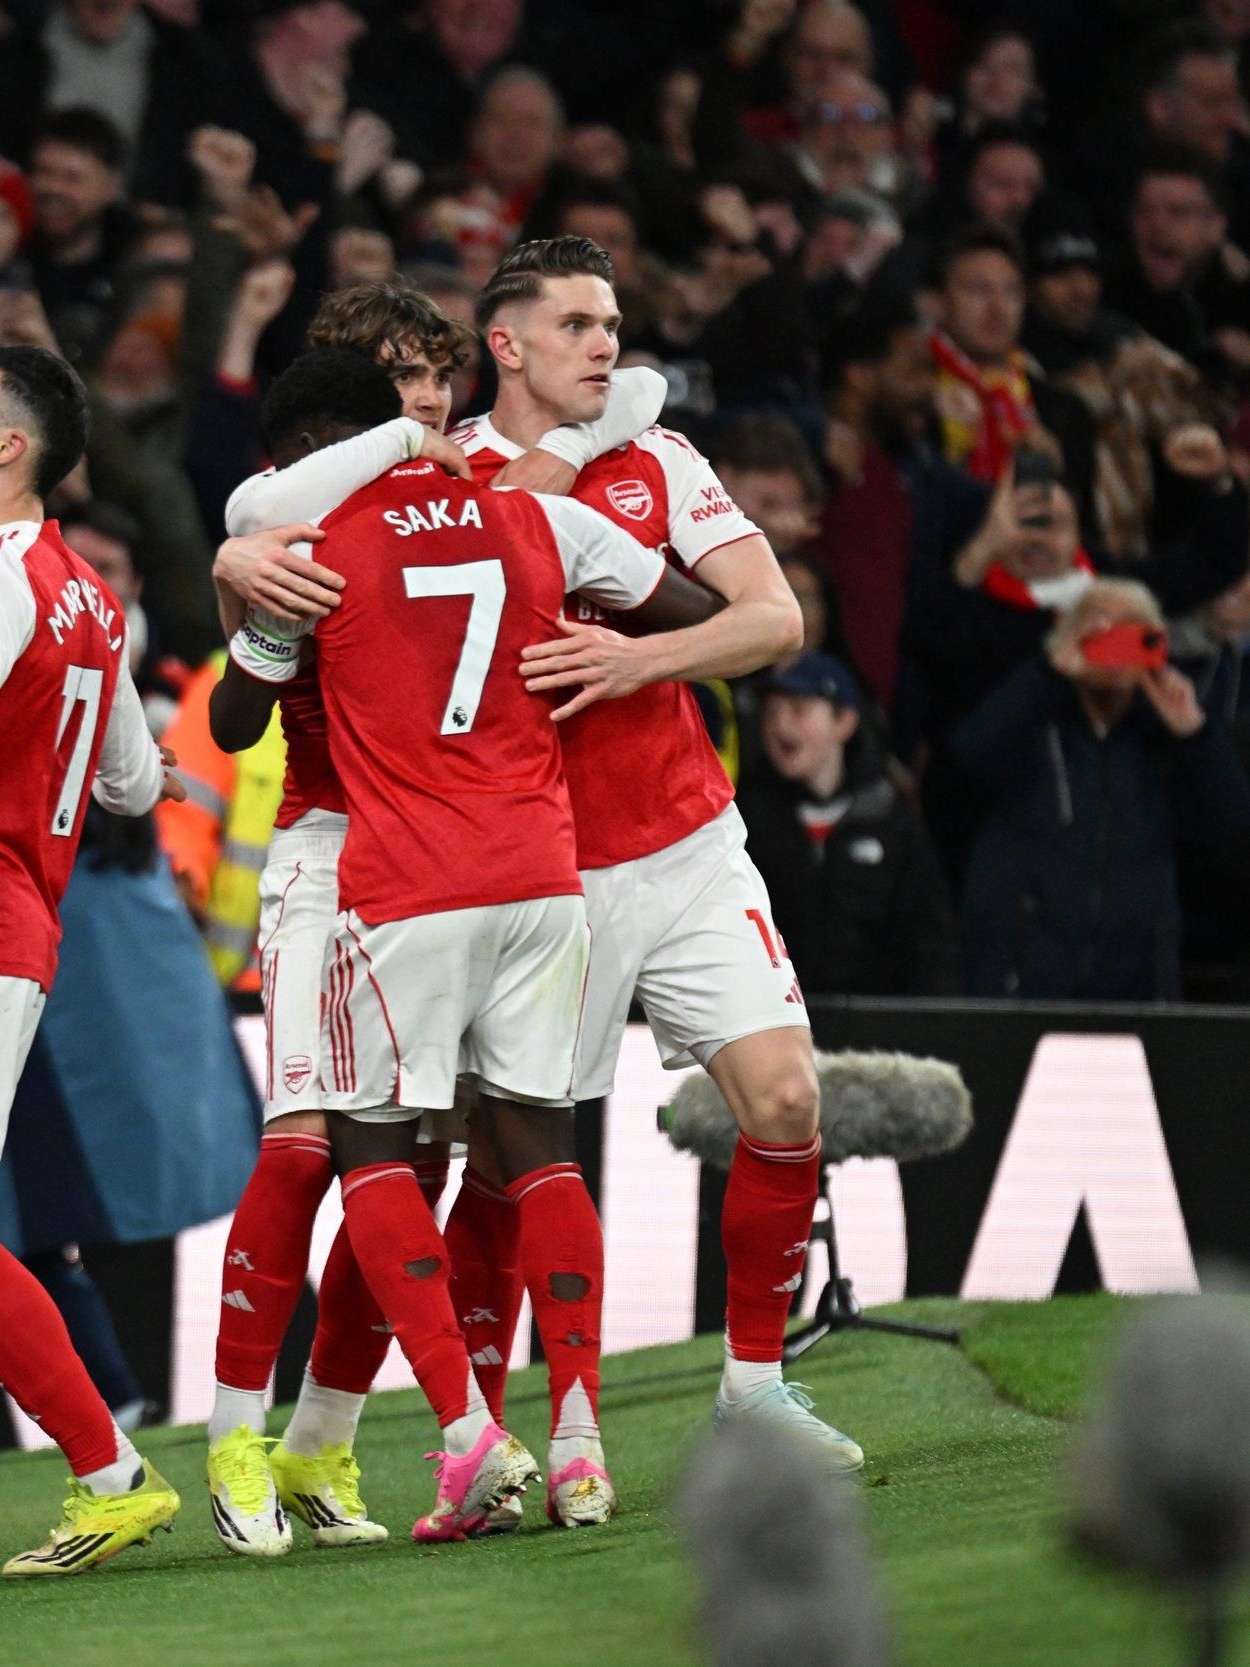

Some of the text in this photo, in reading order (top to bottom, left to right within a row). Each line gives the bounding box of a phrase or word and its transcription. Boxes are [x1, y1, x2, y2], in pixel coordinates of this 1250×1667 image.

[383, 498, 483, 537] SAKA
[243, 625, 291, 656] aptain
[402, 559, 506, 736] 7
